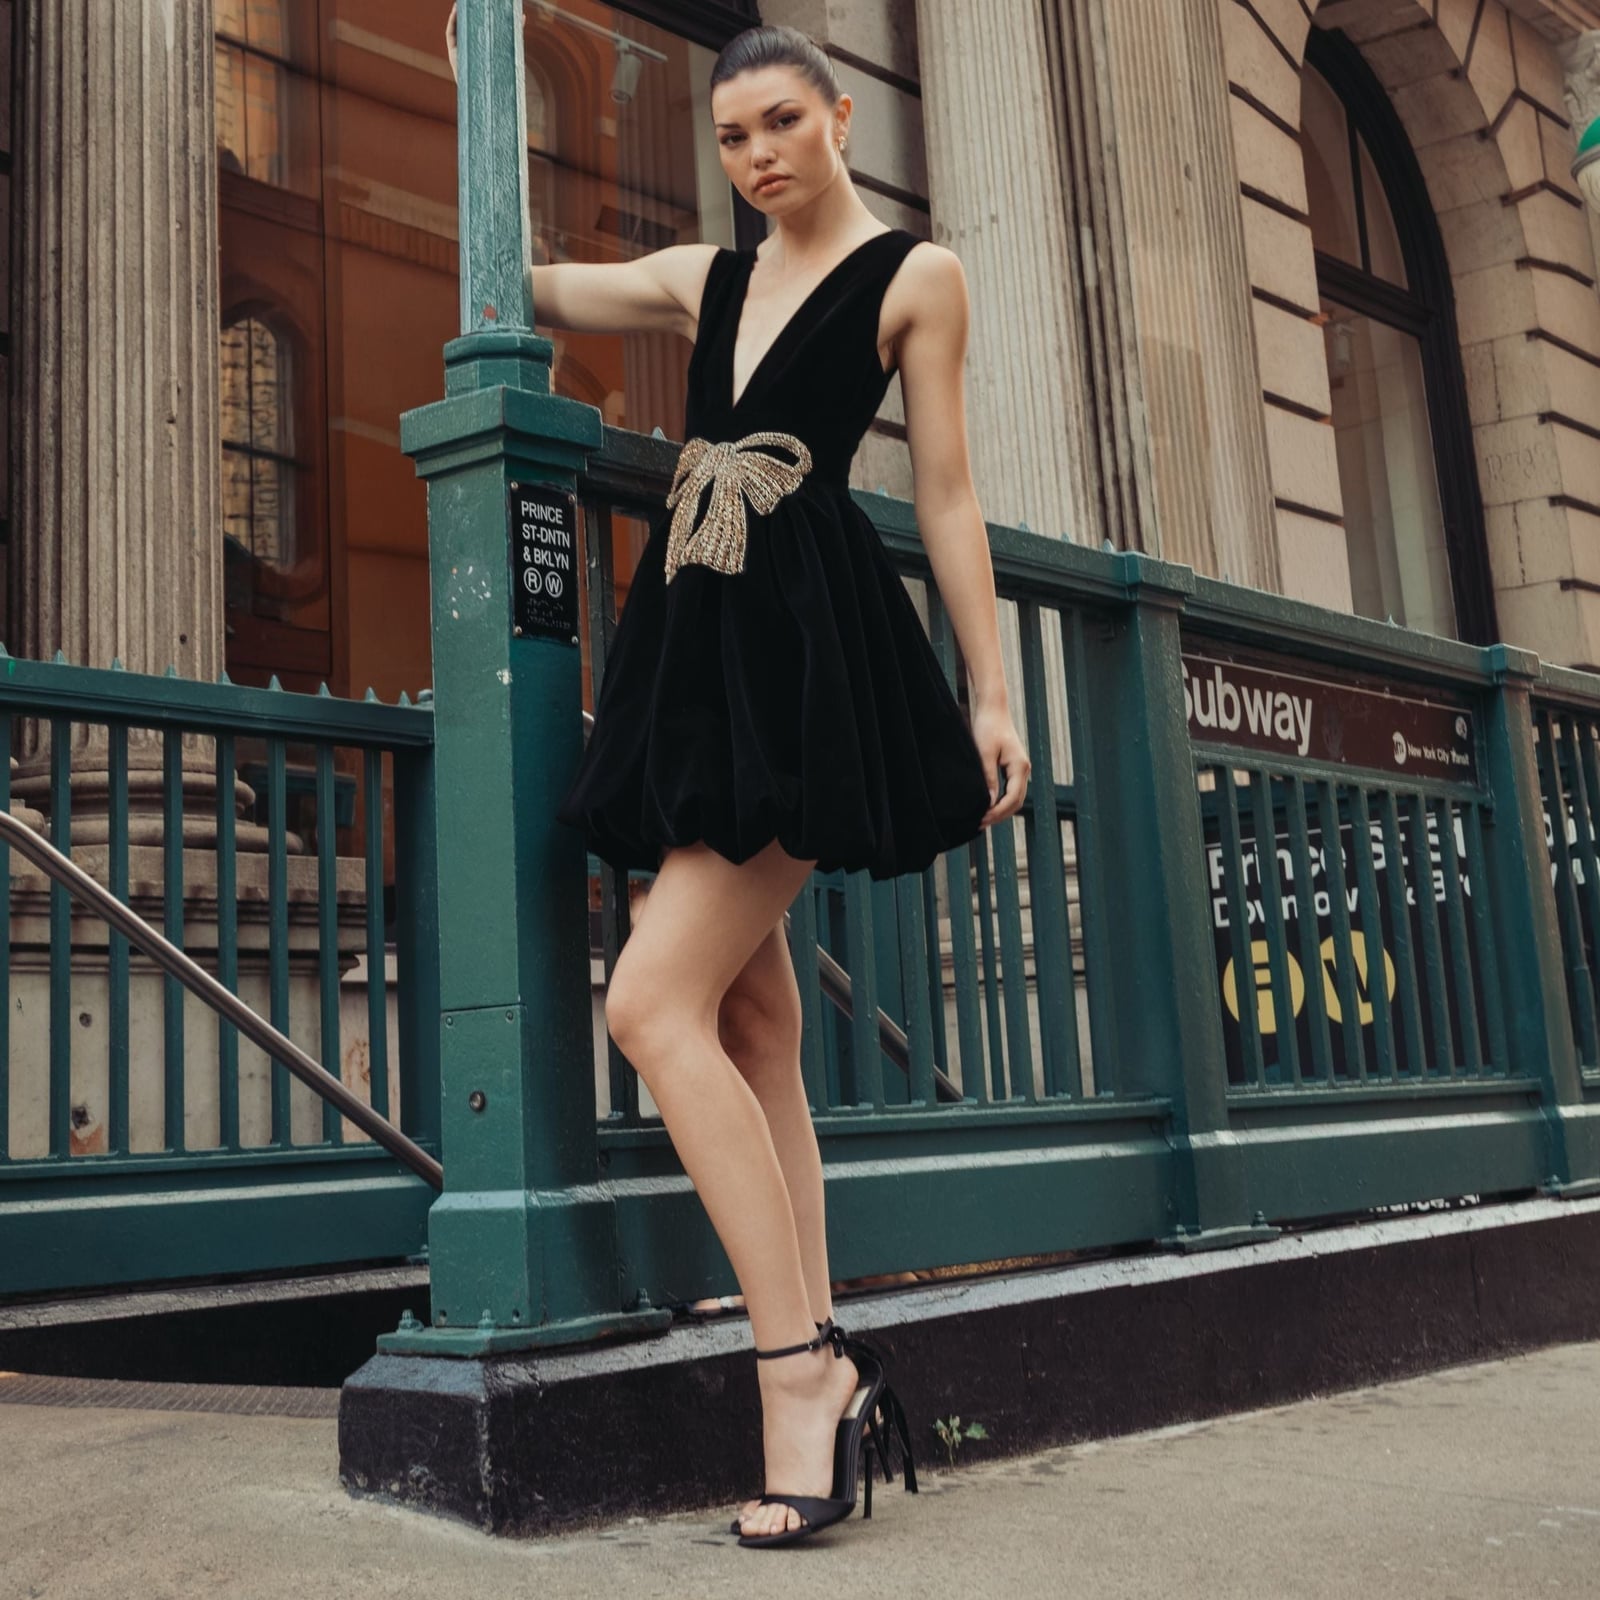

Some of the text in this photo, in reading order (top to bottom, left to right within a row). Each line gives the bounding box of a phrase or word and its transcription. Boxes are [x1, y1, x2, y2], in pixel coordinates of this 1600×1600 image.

[521, 500, 563, 525] PRINCE
[522, 523, 570, 548] ST-DNTN
[523, 546, 569, 570] & BKLYN
[1408, 742, 1422, 758] New
[1423, 745, 1437, 760] York
